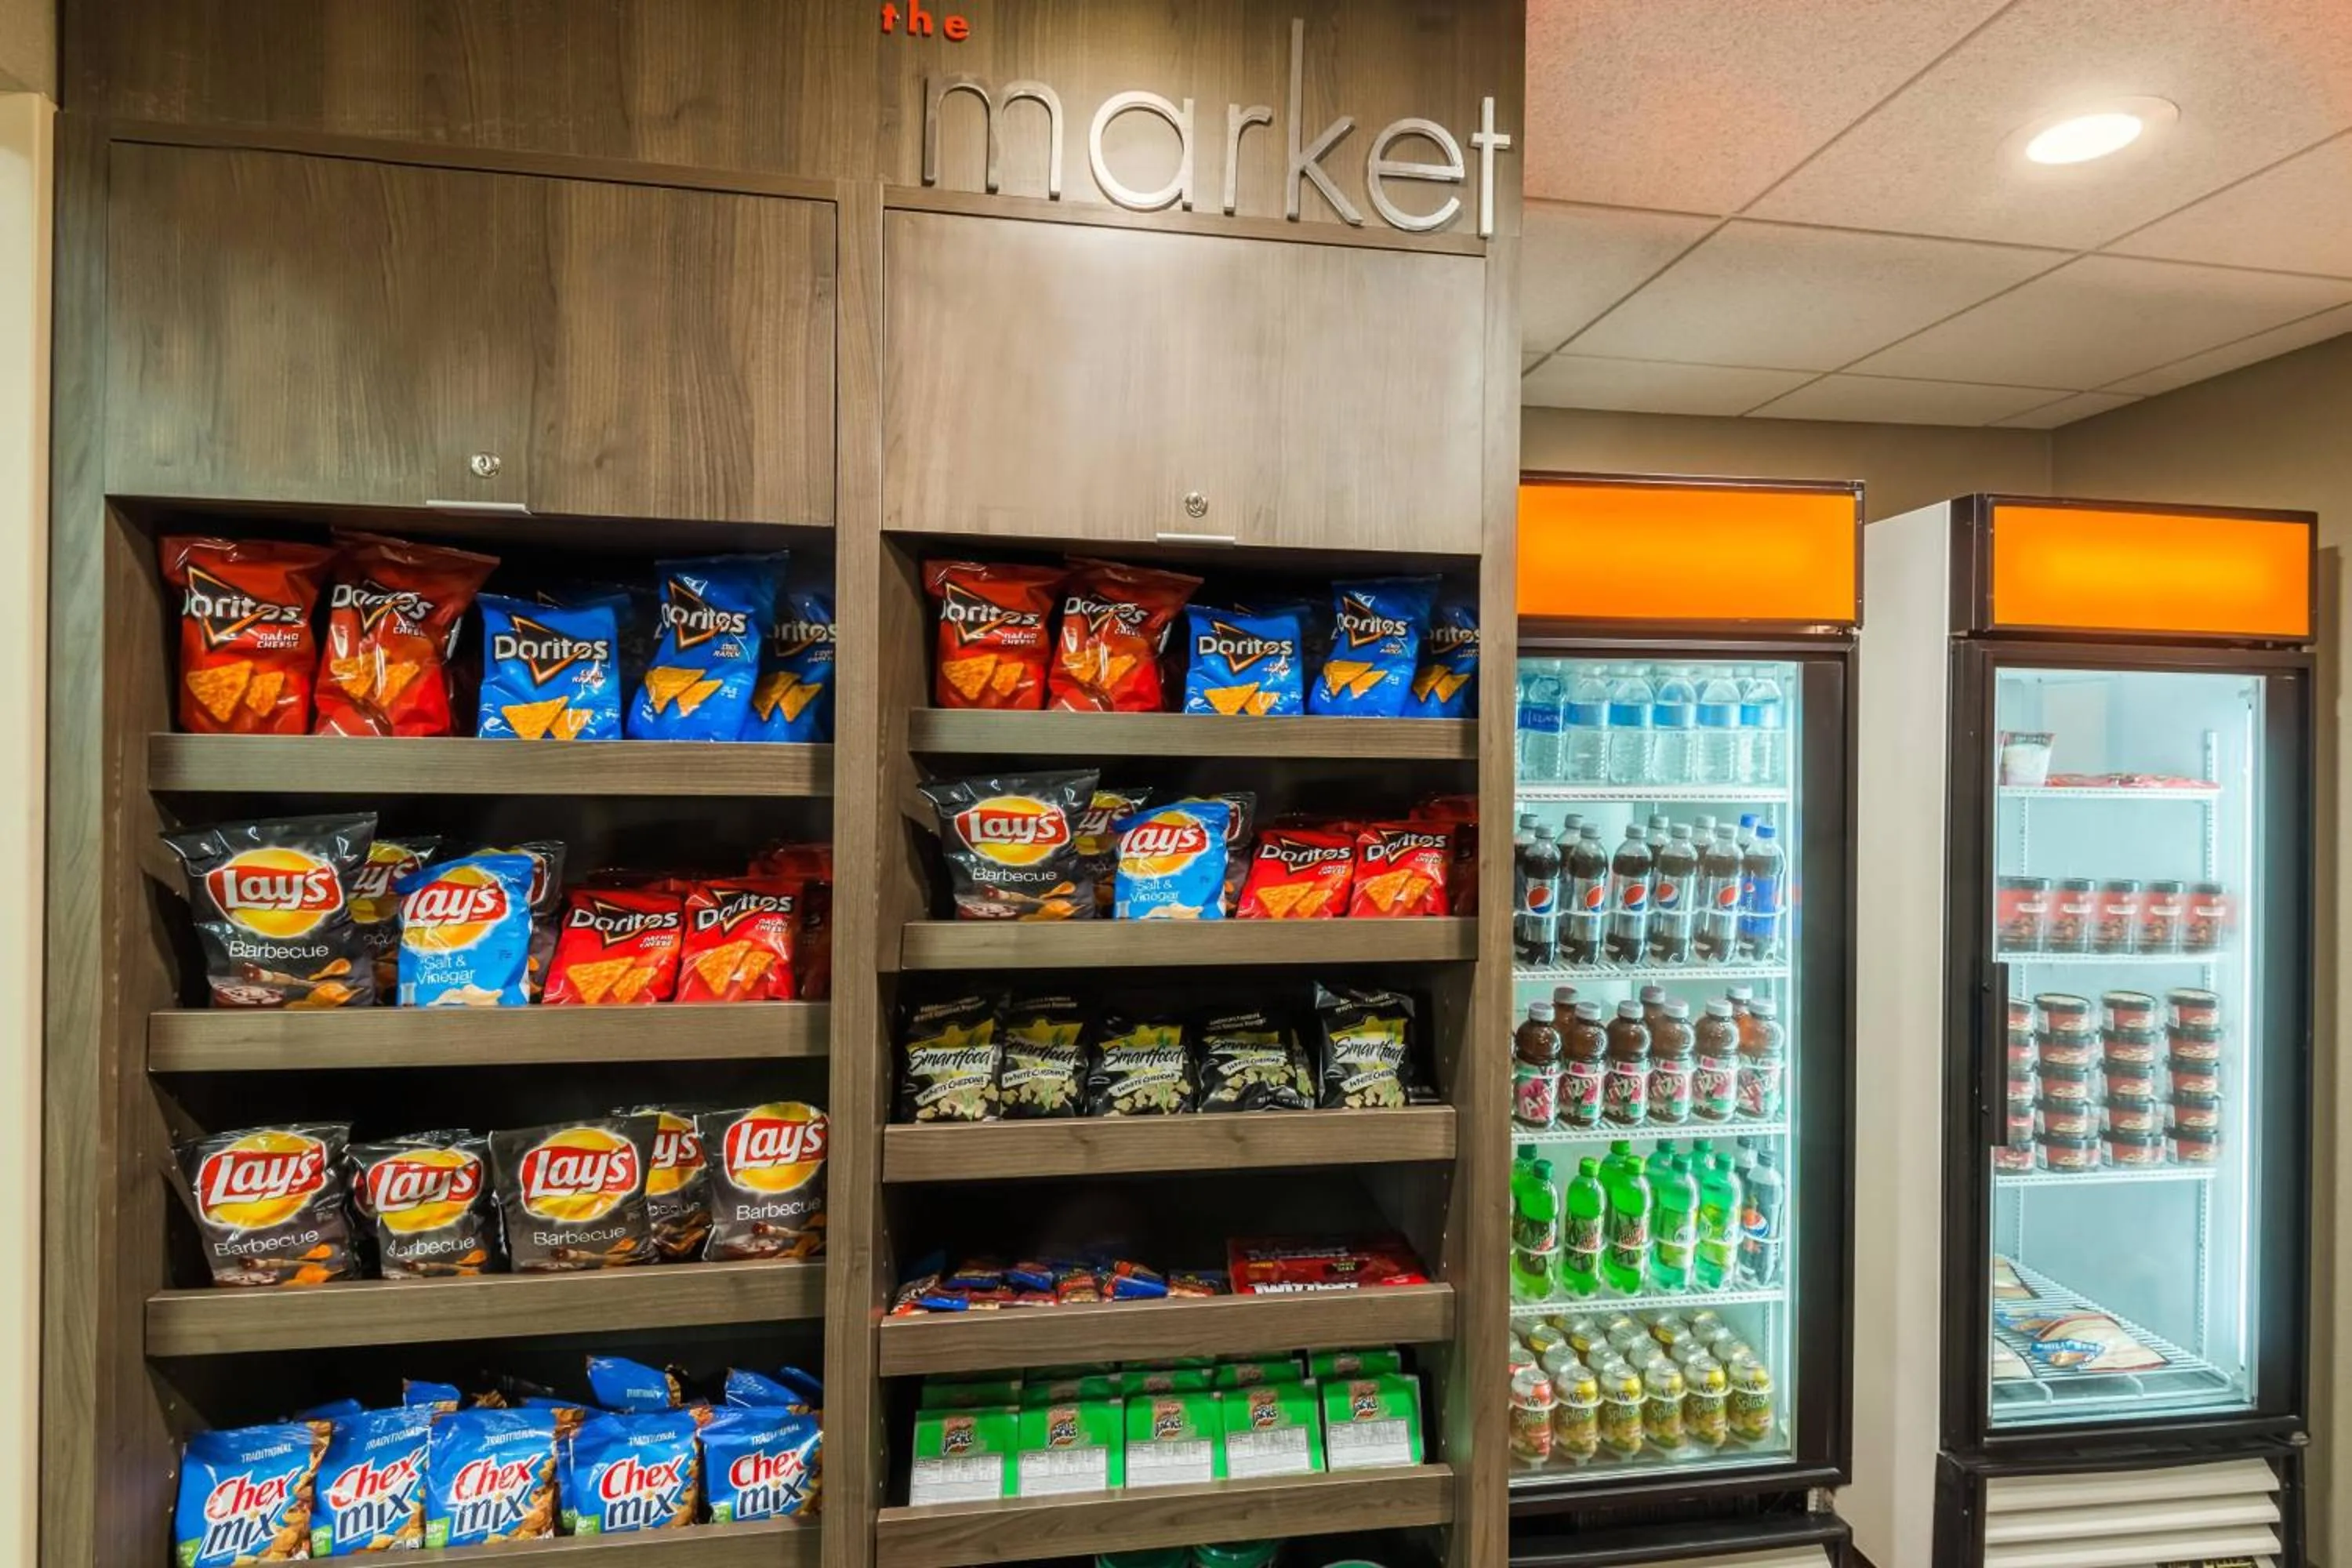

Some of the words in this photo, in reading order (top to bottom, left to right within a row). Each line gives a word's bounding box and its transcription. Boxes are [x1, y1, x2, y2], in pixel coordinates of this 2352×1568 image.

[880, 1, 970, 42] the
[921, 17, 1512, 239] market
[331, 583, 434, 621] Doritos
[1063, 596, 1150, 625] Doritos
[660, 601, 748, 634] Doritos
[1336, 612, 1407, 637] Doritos
[493, 633, 609, 661] Doritos
[1198, 636, 1294, 656] Doritos
[970, 810, 1058, 845] Lay's
[1120, 826, 1200, 858] Lay's
[1260, 844, 1352, 864] Doritos
[1366, 832, 1447, 862] Doritos
[223, 864, 331, 909] Lay's
[972, 867, 1058, 883] Barbecue
[1137, 879, 1160, 891] Salt
[1163, 878, 1173, 889] &
[403, 883, 499, 928] Lay's
[697, 889, 793, 931] Doritos
[1129, 890, 1179, 904] Vinegar
[569, 907, 679, 933] Doritos
[228, 940, 329, 960] Barbecue
[423, 955, 452, 971] Salt
[456, 954, 466, 968] &
[416, 968, 476, 985] Vinegar
[909, 1044, 995, 1073] Smartfood
[1005, 1033, 1076, 1065] Smartfood
[1103, 1045, 1185, 1068] Smartfood
[1334, 1036, 1406, 1062] Smartfood
[731, 1114, 827, 1171] Lay's
[208, 1149, 320, 1206] Lay's
[529, 1142, 631, 1200] Lay's
[376, 1160, 477, 1212] Lay's
[648, 1200, 702, 1218] becue
[736, 1198, 822, 1222] Barbecue
[213, 1229, 319, 1257] Barbecue
[387, 1236, 477, 1257] Barbecue
[533, 1225, 627, 1247] Barbecue
[365, 1426, 426, 1451] TRADITIONAL
[485, 1428, 538, 1447] TRADITIONAL
[627, 1430, 677, 1446] TRADITIONAL
[751, 1423, 801, 1446] TRADITIONAL
[240, 1443, 293, 1464] TRADITIONAL
[730, 1448, 808, 1488] Chex
[330, 1448, 427, 1510] Chex
[453, 1454, 541, 1502] Chex
[601, 1454, 687, 1501] Chex
[206, 1468, 298, 1519] Chex
[607, 1486, 679, 1529] mix
[739, 1473, 808, 1518] mix
[338, 1480, 415, 1537] mix
[456, 1485, 528, 1537] mix
[204, 1502, 283, 1557] mix
